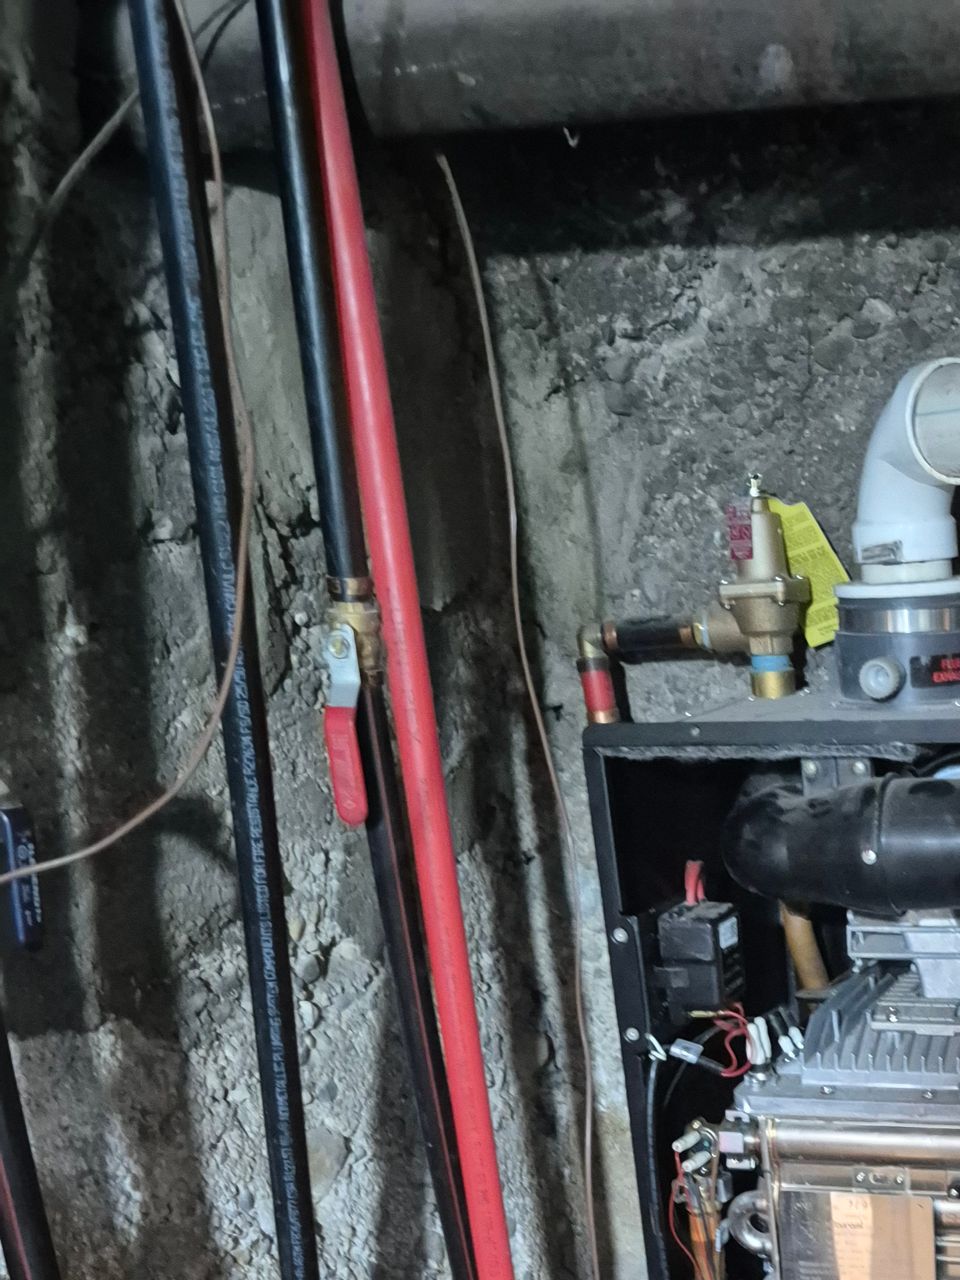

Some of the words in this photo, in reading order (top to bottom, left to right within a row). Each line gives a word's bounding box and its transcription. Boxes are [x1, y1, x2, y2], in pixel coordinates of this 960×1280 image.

[244, 775, 262, 838] RESISTANCE
[250, 839, 265, 863] FIRE
[251, 863, 266, 884] FOR
[255, 884, 270, 920] LISTED
